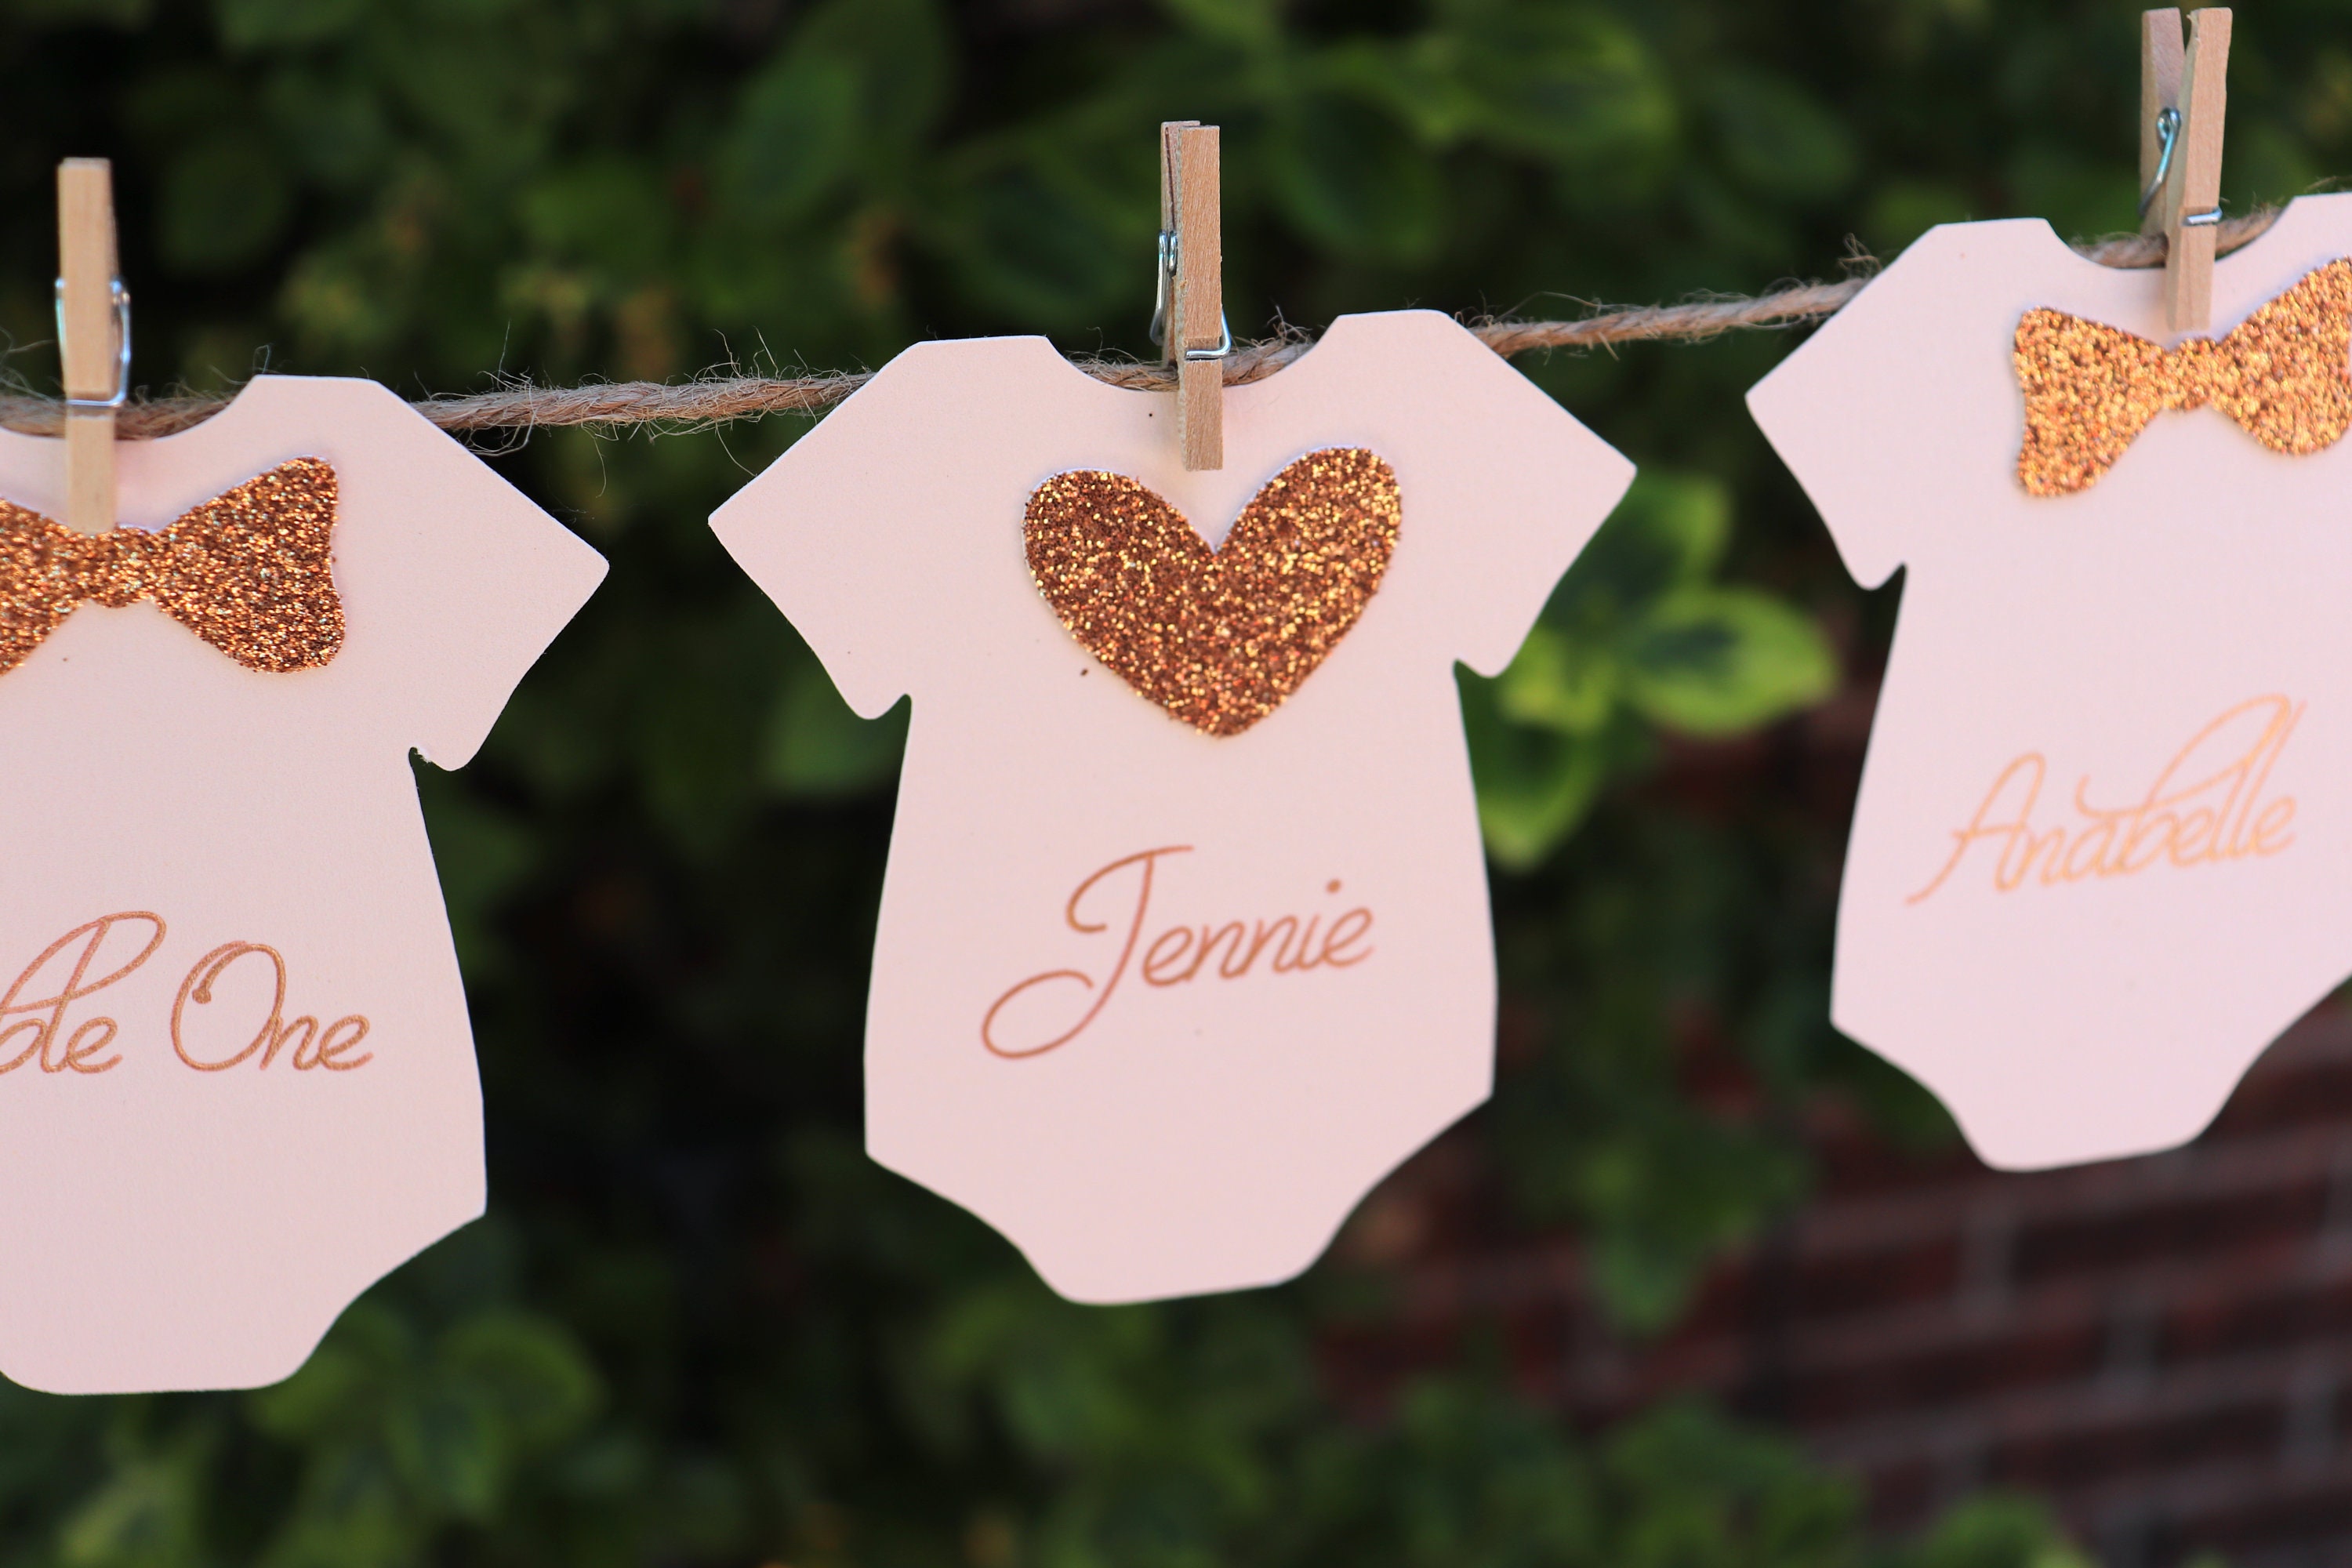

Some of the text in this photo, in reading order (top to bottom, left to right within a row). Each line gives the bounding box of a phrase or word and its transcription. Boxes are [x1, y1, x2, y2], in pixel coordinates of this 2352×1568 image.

[1905, 693, 2307, 906] Anabelle
[170, 941, 374, 1071] One
[981, 844, 1374, 1060] Jennie
